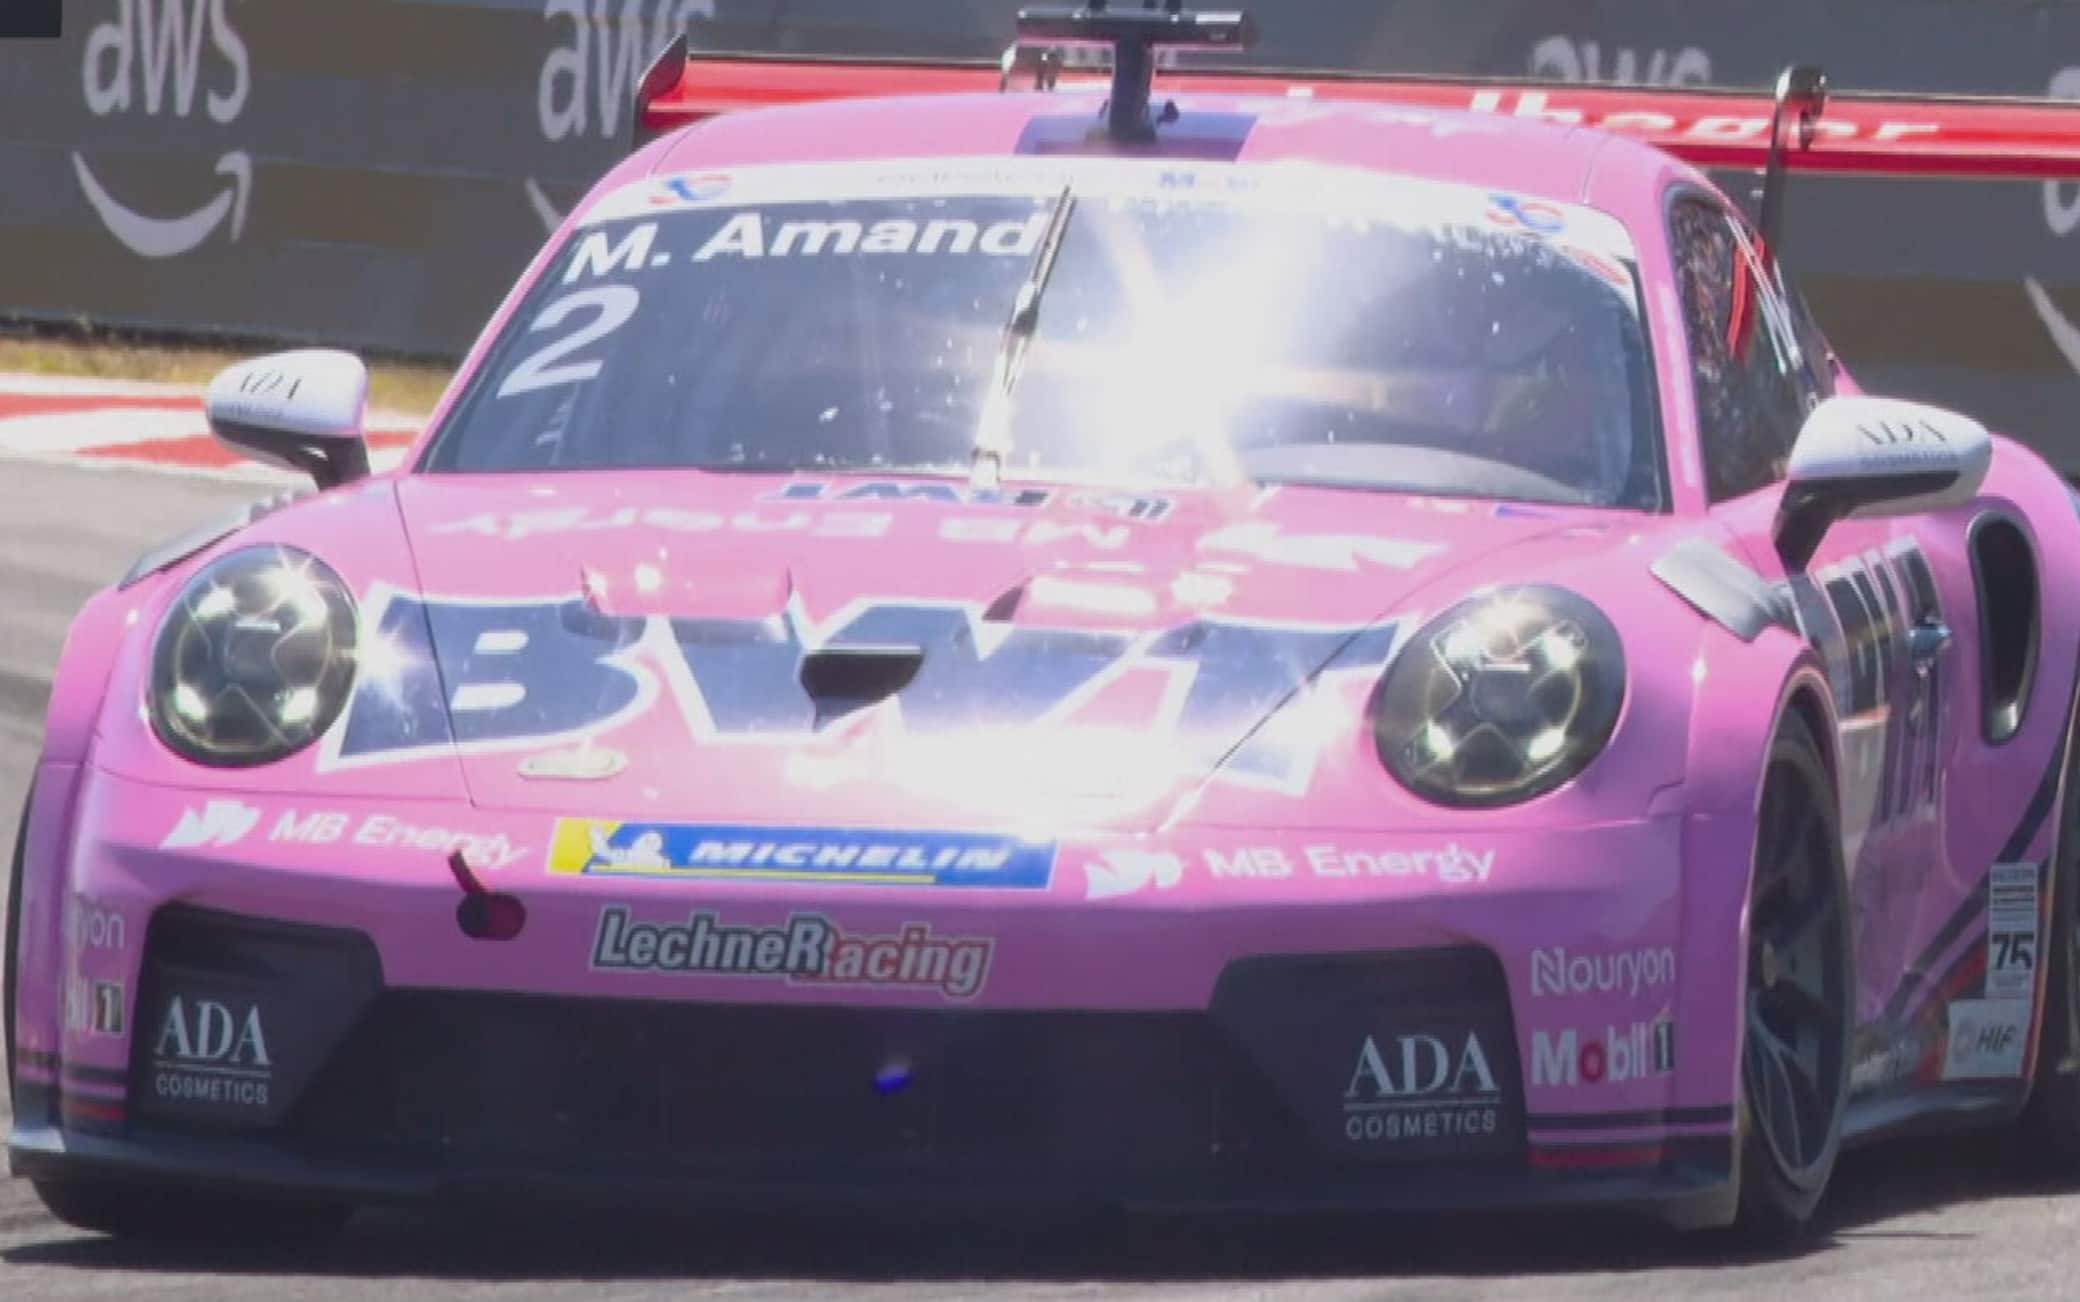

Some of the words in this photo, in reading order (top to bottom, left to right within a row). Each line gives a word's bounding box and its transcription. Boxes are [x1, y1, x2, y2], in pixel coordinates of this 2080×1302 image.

[82, 0, 250, 123] aws
[562, 222, 672, 284] M.
[692, 211, 1050, 262] Amand
[497, 284, 640, 399] 2
[270, 810, 348, 843] MB
[353, 815, 530, 869] Energy
[689, 840, 1013, 870] MICHELIN
[1203, 846, 1293, 879] MB
[1305, 842, 1497, 883] Energy
[1530, 946, 1677, 998] Nouryon
[1990, 932, 2035, 971] 75
[153, 995, 272, 1066] ADA
[1531, 1022, 1647, 1087] Mobil
[1653, 1021, 1676, 1074] 1
[155, 1071, 269, 1106] COSMETICS
[1344, 1029, 1500, 1098] ADA
[1345, 1108, 1497, 1140] COSMETICS
